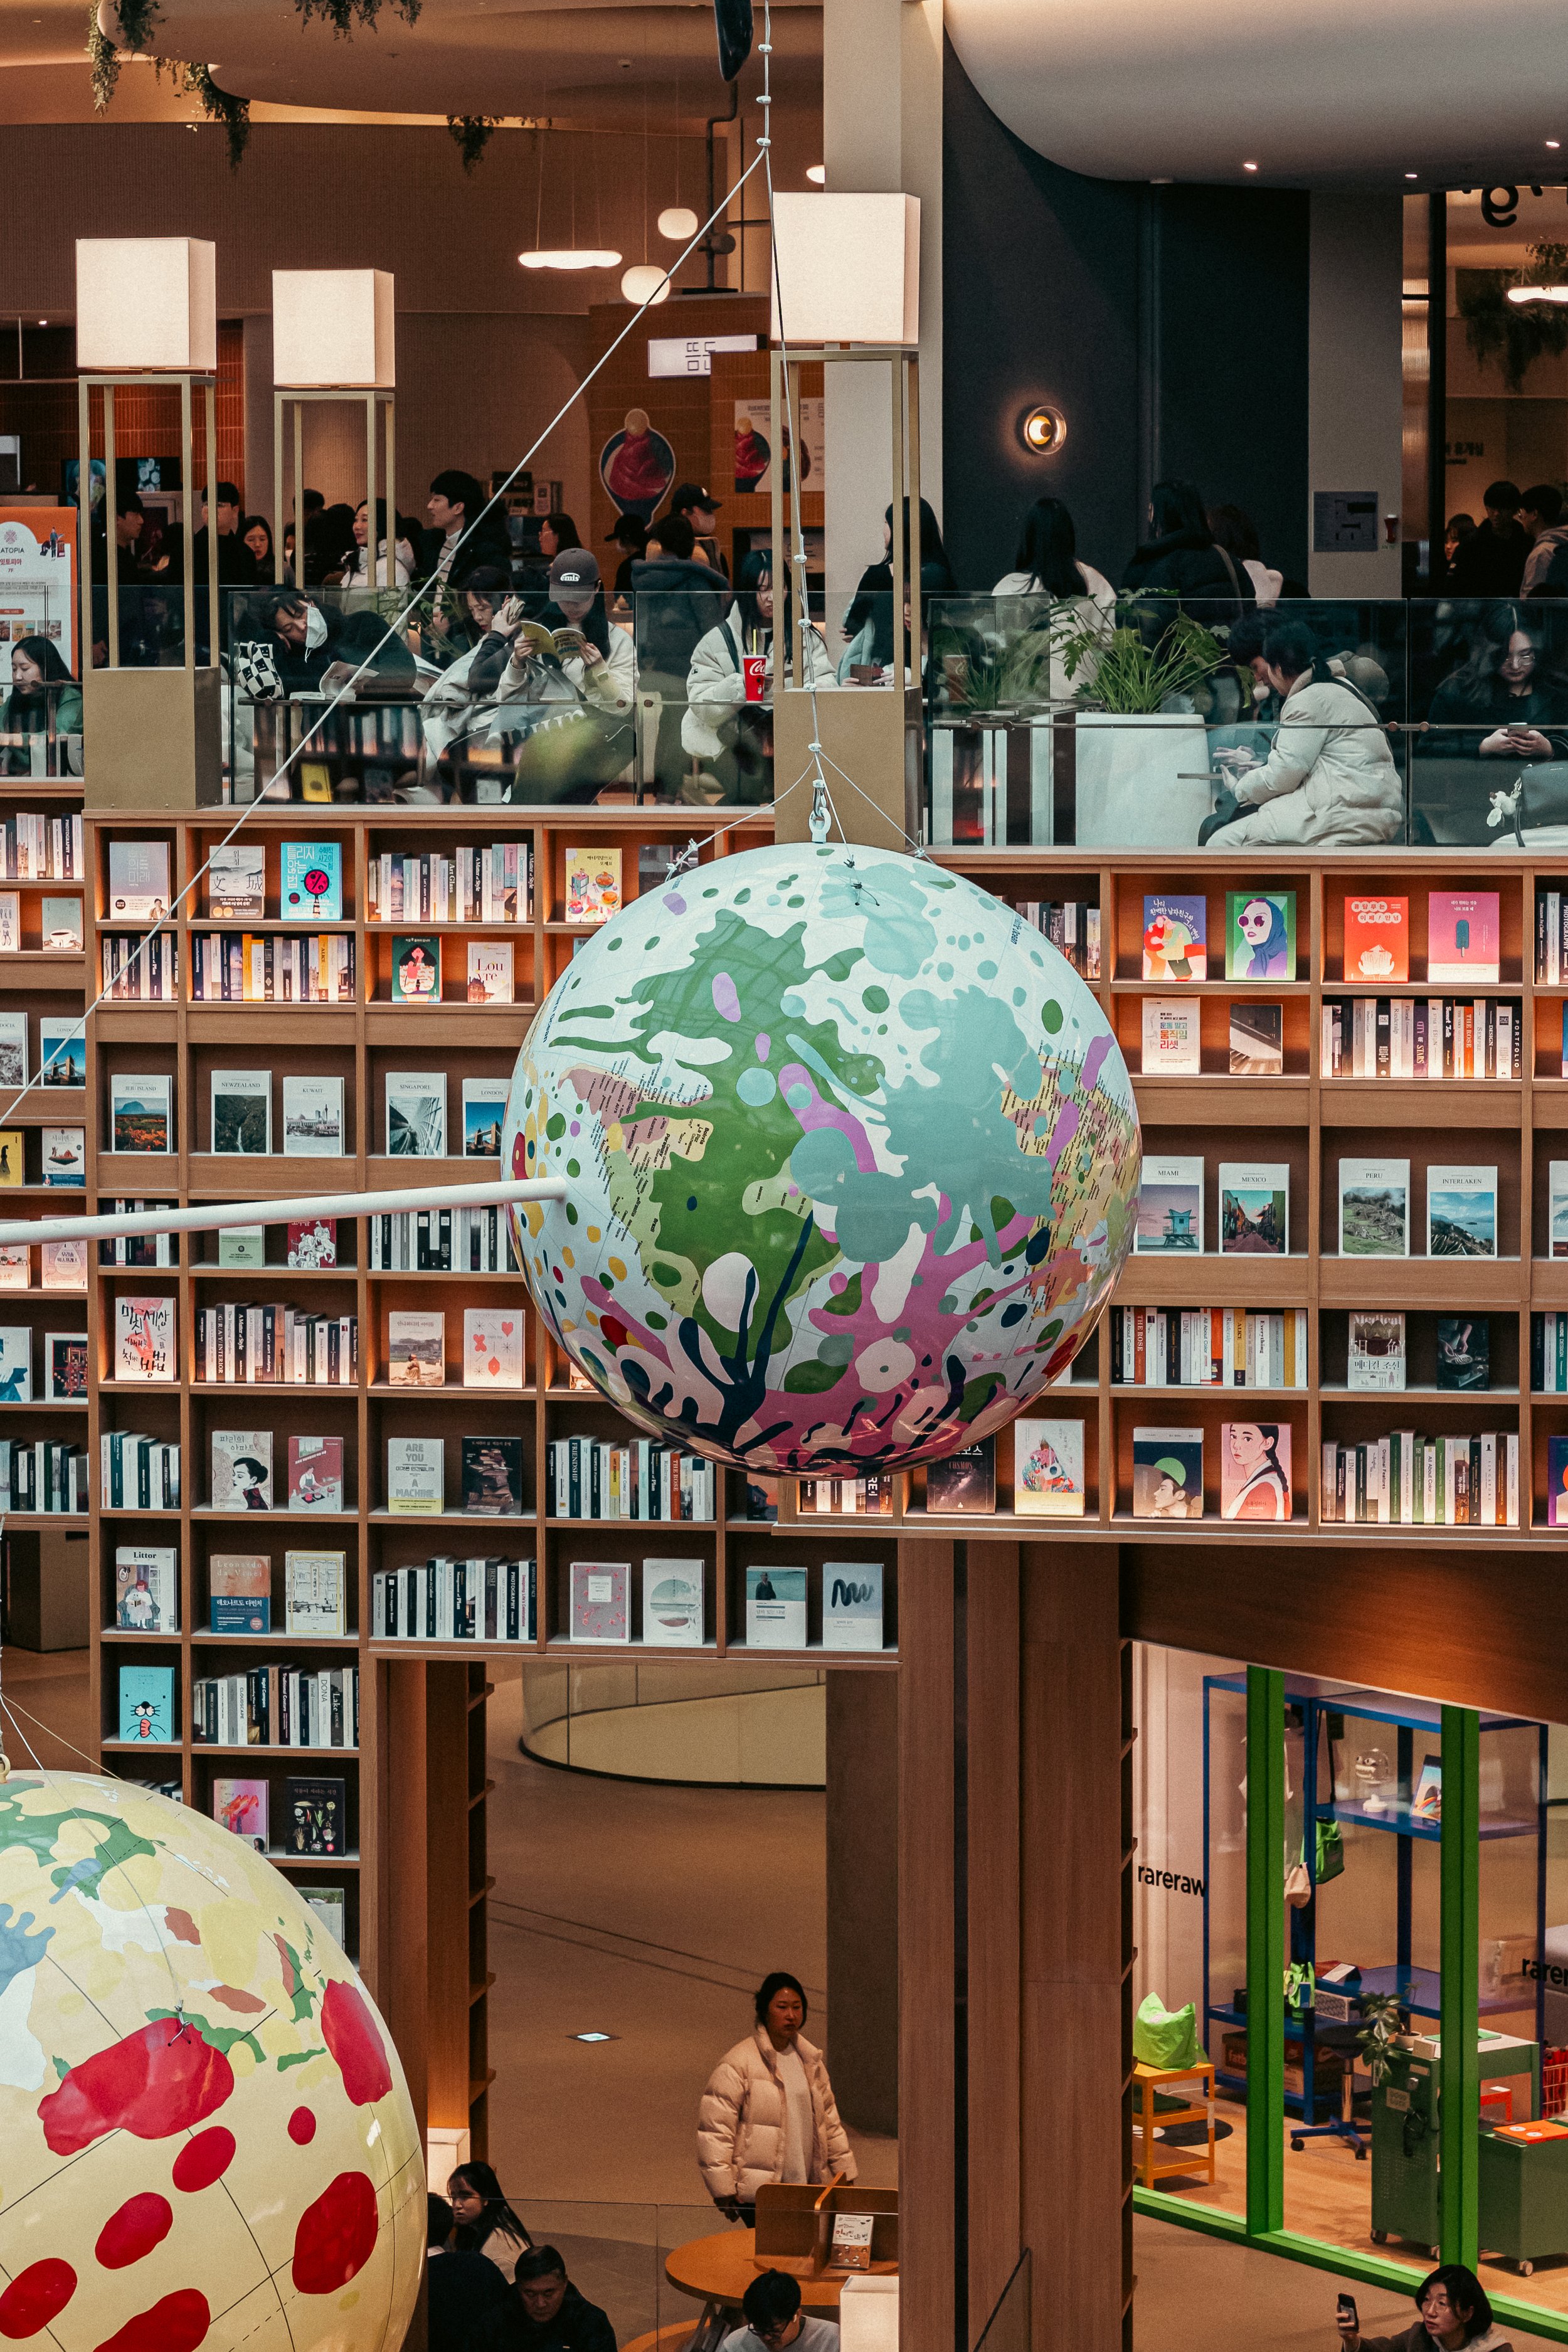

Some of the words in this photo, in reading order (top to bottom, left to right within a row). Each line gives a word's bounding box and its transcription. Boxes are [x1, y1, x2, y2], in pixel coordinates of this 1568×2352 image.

[560, 573, 580, 582] emis
[287, 845, 315, 860] 틀리지
[287, 862, 307, 875] 않는
[211, 876, 226, 893] 文
[287, 875, 299, 889] 법
[1153, 898, 1165, 907] 나의
[477, 958, 503, 971] Lou
[1160, 1030, 1187, 1039] 움직임
[1160, 1040, 1178, 1050] 리셋
[1416, 1044, 1425, 1063] STARS
[626, 1093, 636, 1114] Santiago
[647, 1117, 657, 1139] Asuncion
[627, 1123, 638, 1149] Argentina
[699, 1127, 709, 1145] Bolivia
[659, 1133, 670, 1157] Paraguay
[220, 1435, 245, 1443] 파리의
[405, 1444, 425, 1452] ARE
[406, 1454, 424, 1462] YOU
[411, 1479, 418, 1487] A
[396, 1489, 434, 1498] MACHINE
[1137, 1864, 1207, 1897] rareraw
